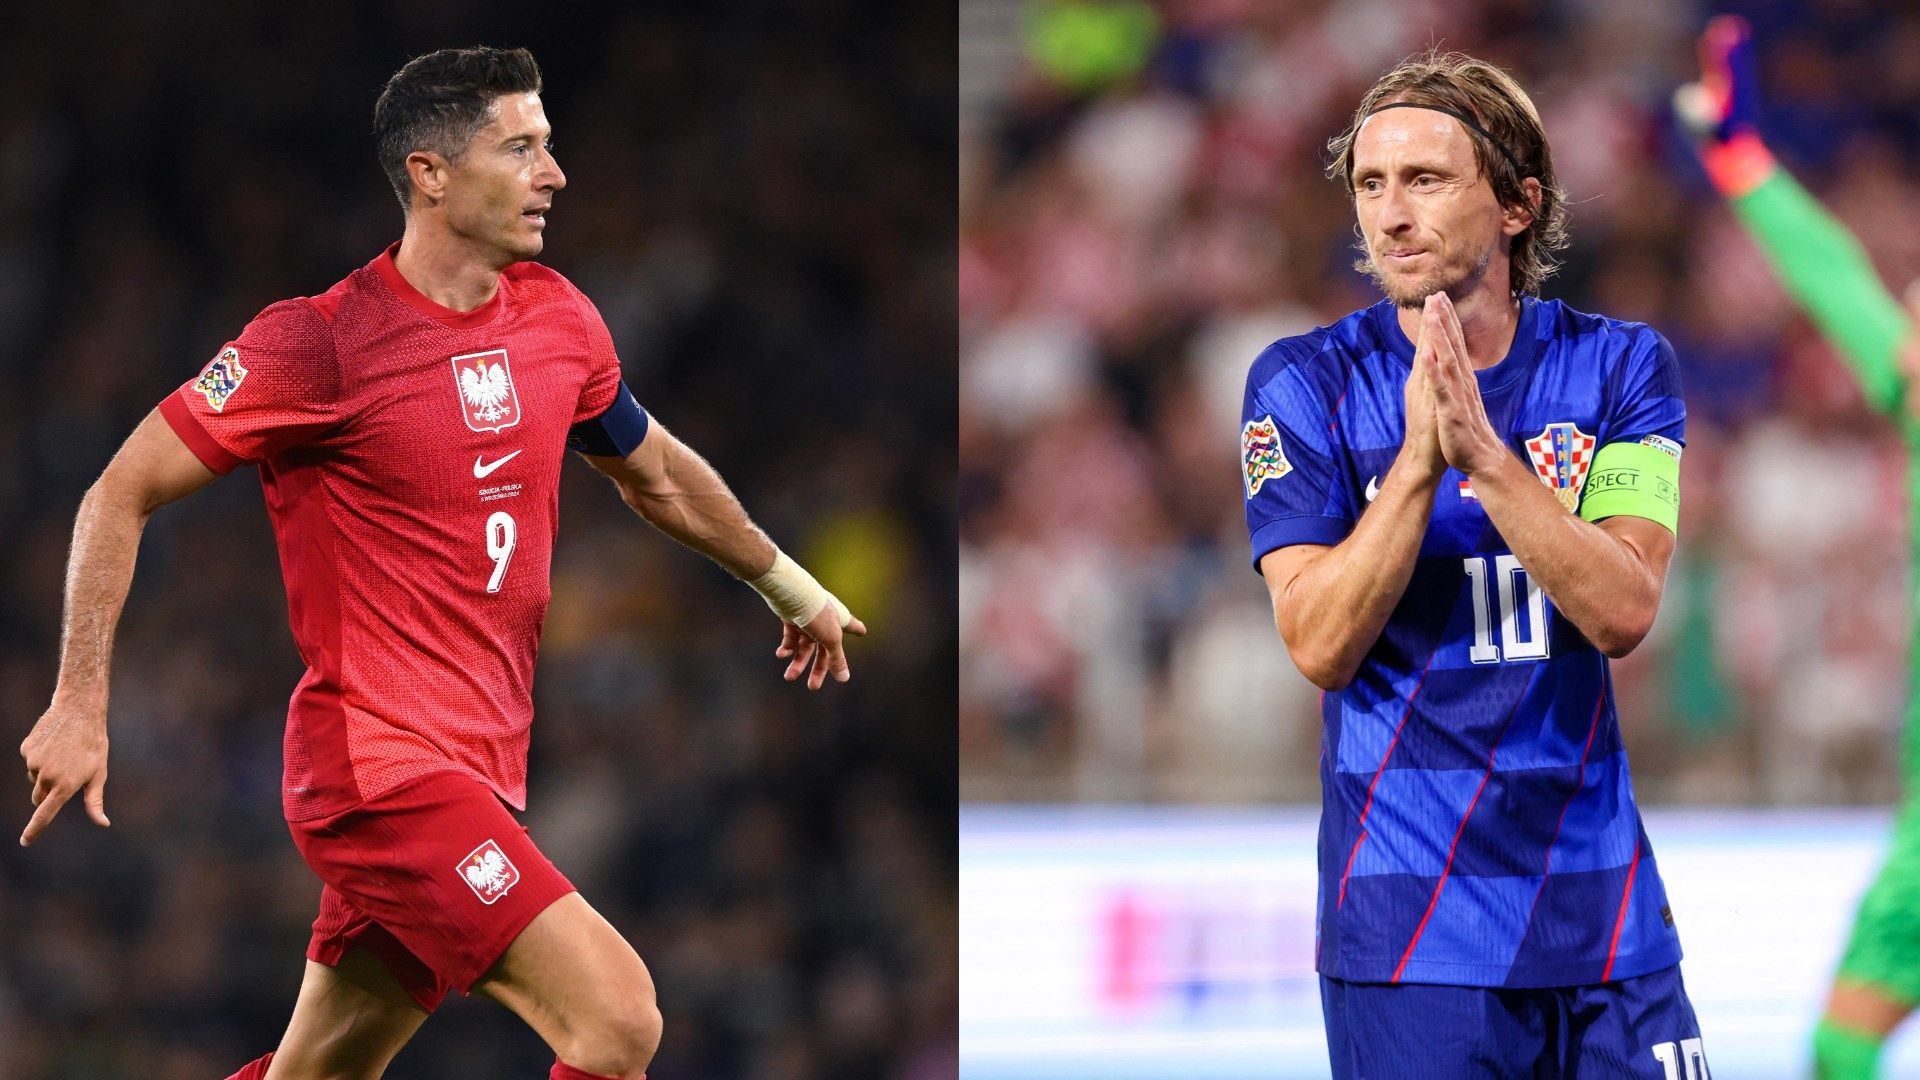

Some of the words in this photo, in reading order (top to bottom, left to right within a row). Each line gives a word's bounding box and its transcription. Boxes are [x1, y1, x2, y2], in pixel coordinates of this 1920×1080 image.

[1556, 433, 1568, 479] HNS
[486, 511, 517, 593] 9
[1463, 555, 1550, 664] 10
